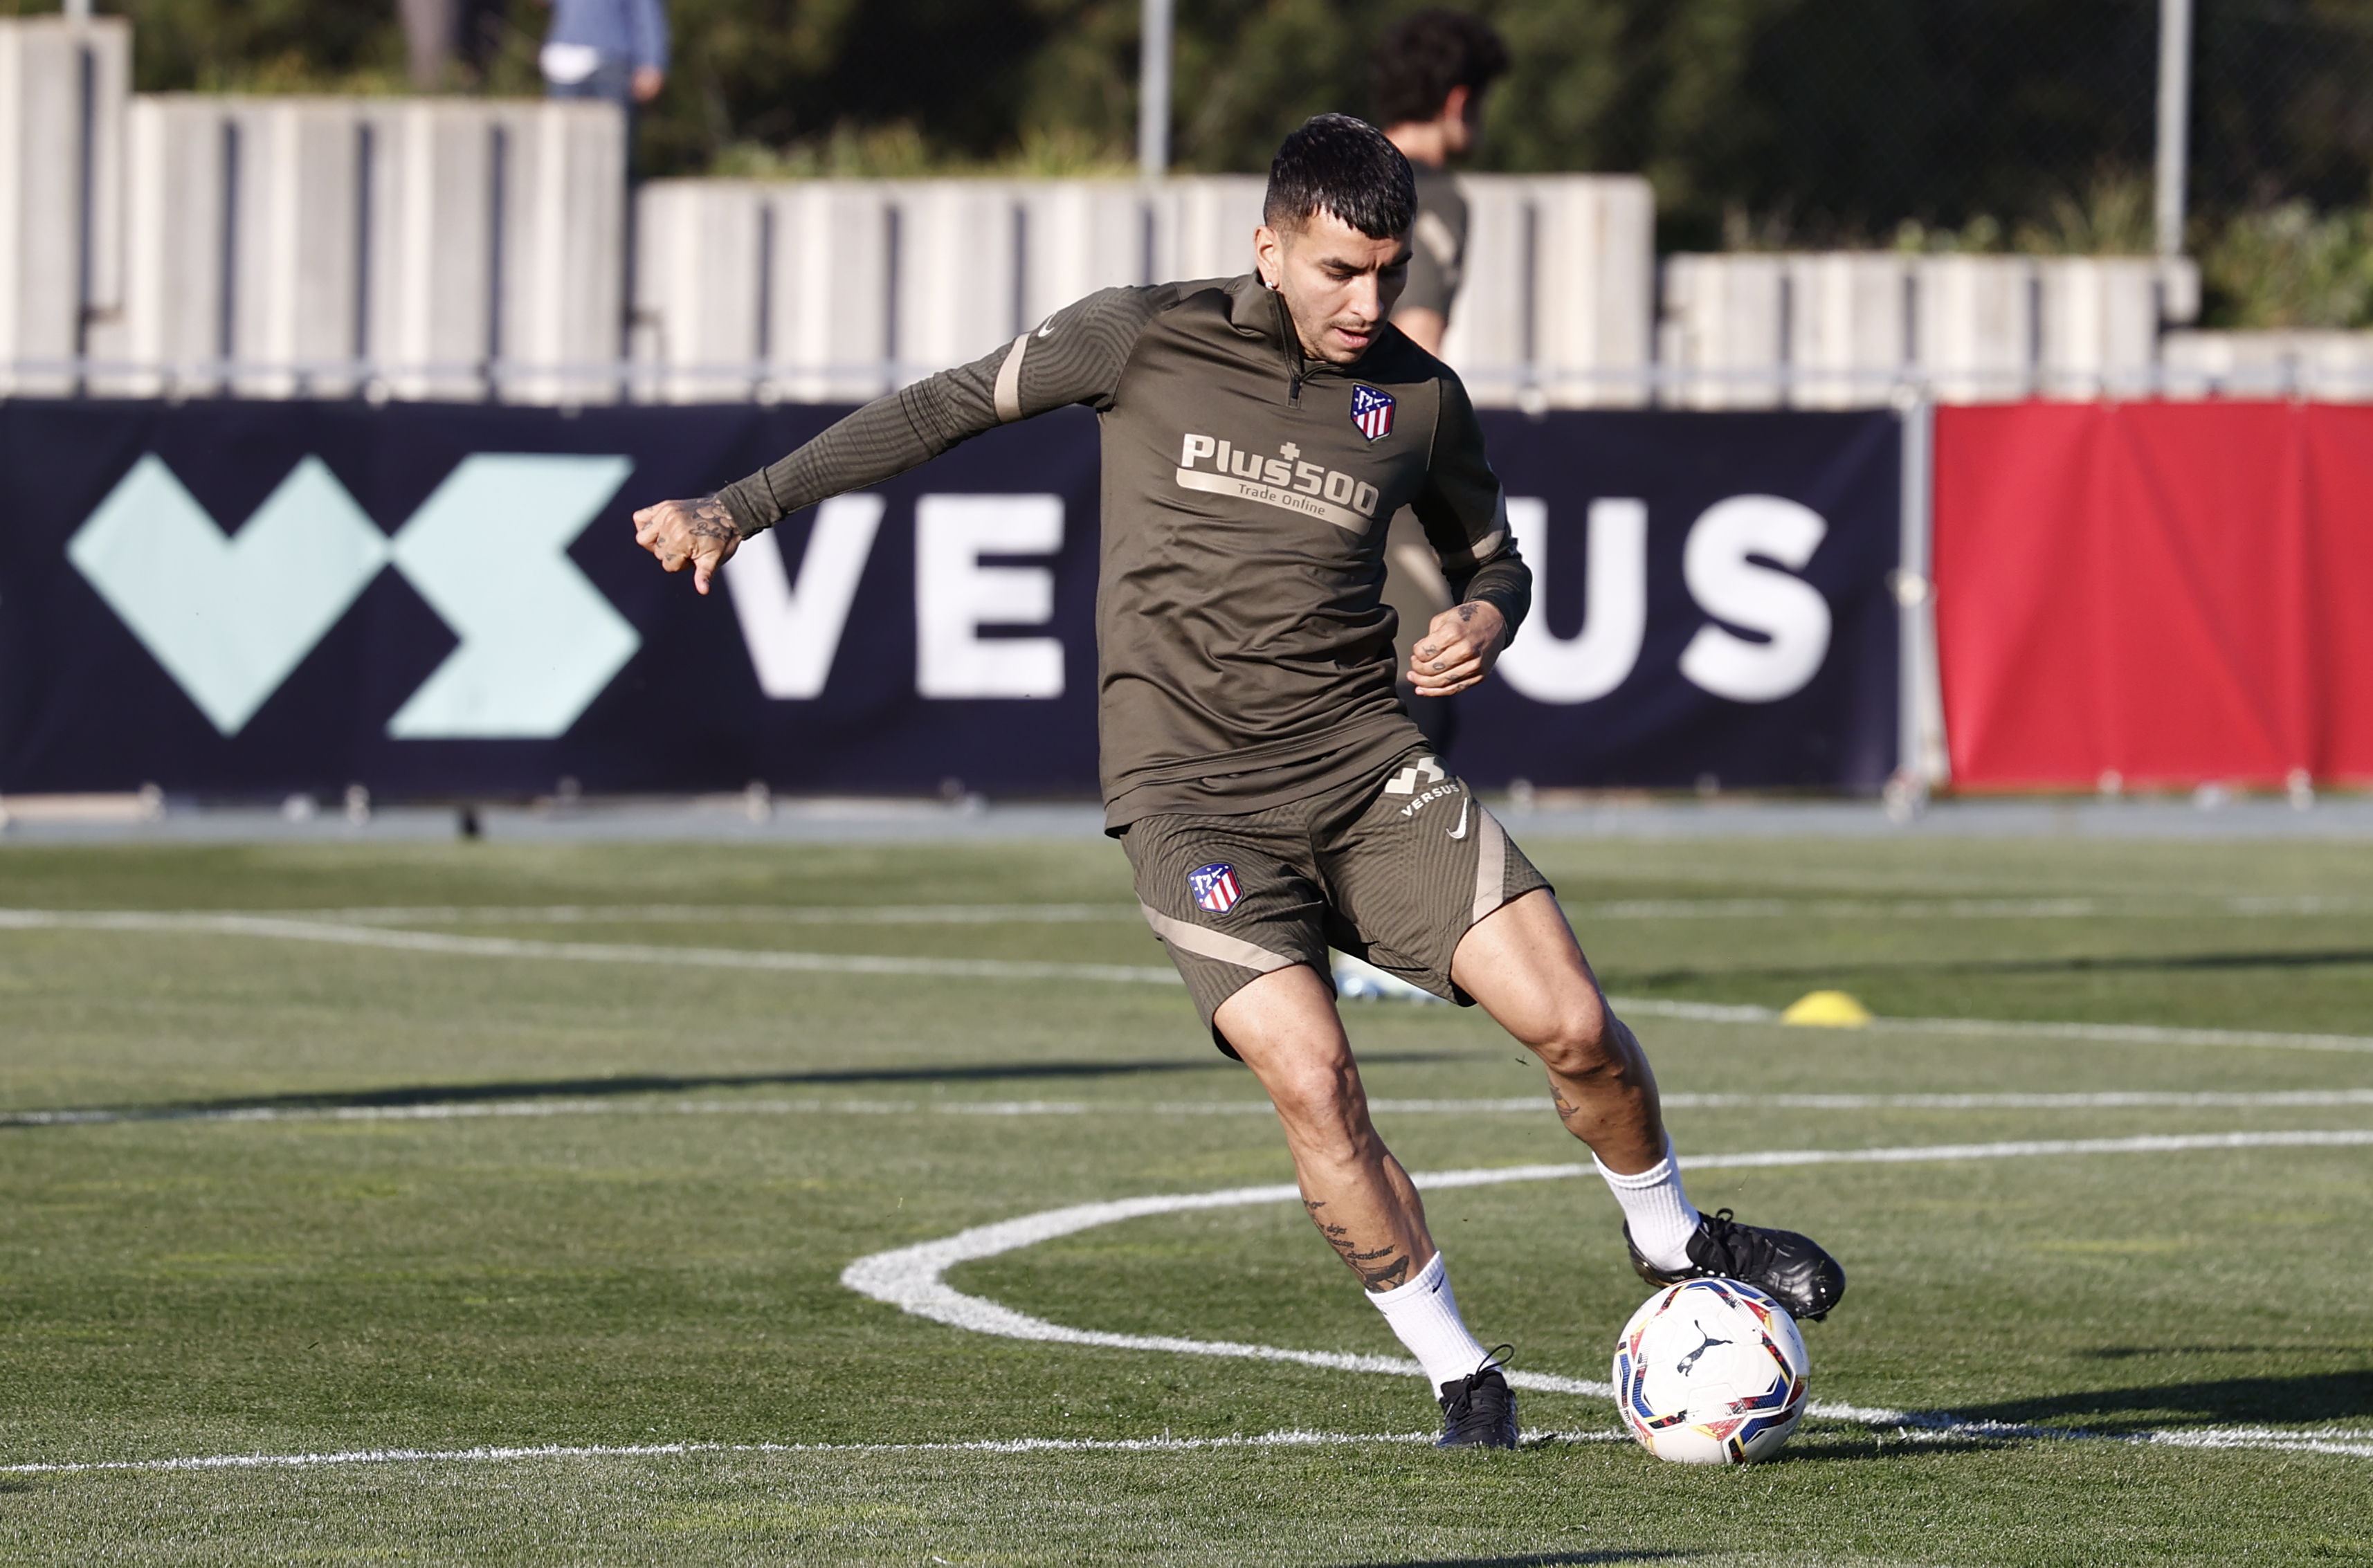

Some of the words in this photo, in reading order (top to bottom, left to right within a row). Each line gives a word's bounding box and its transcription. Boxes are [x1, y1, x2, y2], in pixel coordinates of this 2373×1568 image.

[1181, 433, 1379, 517] Plus500
[1238, 483, 1277, 502] Trade
[1282, 495, 1326, 516] Online
[1401, 784, 1460, 817] VERSUS
